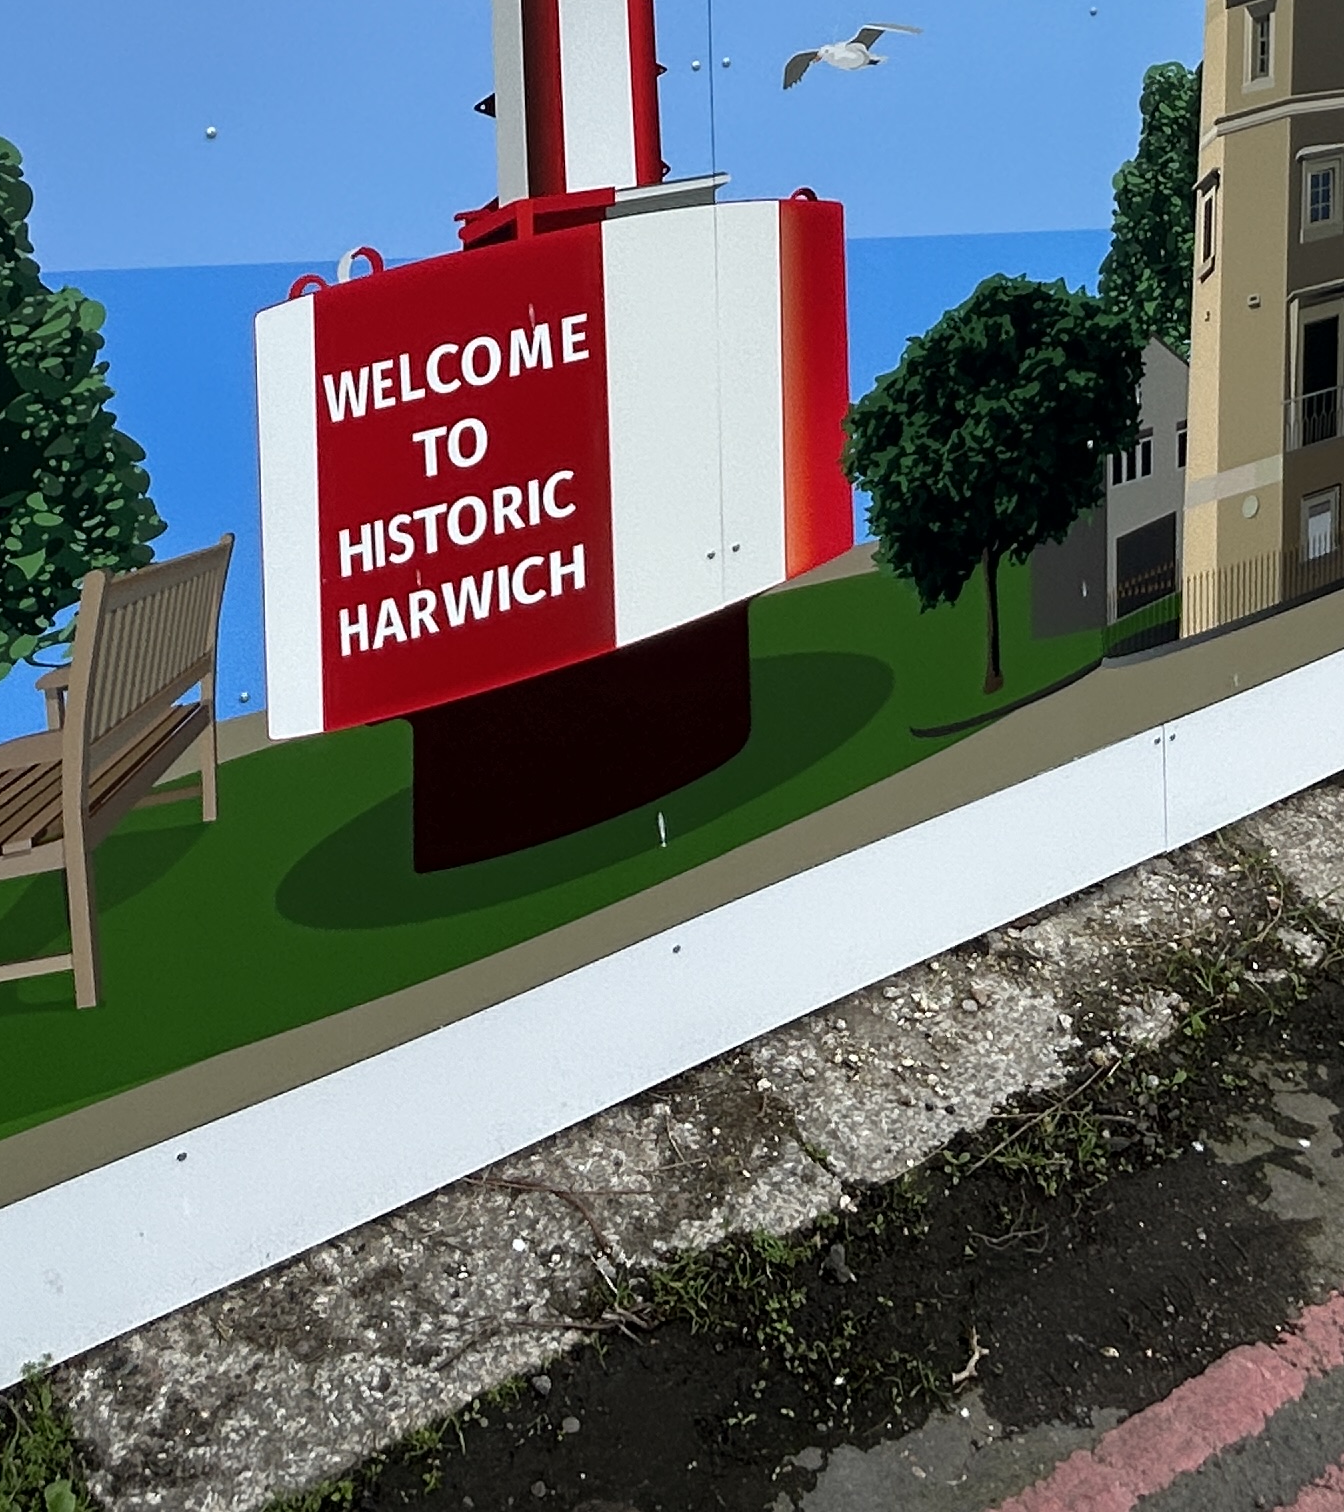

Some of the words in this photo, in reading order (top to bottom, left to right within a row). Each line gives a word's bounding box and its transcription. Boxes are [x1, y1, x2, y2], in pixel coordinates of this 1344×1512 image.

[323, 314, 589, 422] WELCOME
[413, 418, 487, 477] TO
[339, 471, 576, 577] HISTORIC
[340, 544, 585, 656] HARWICH
